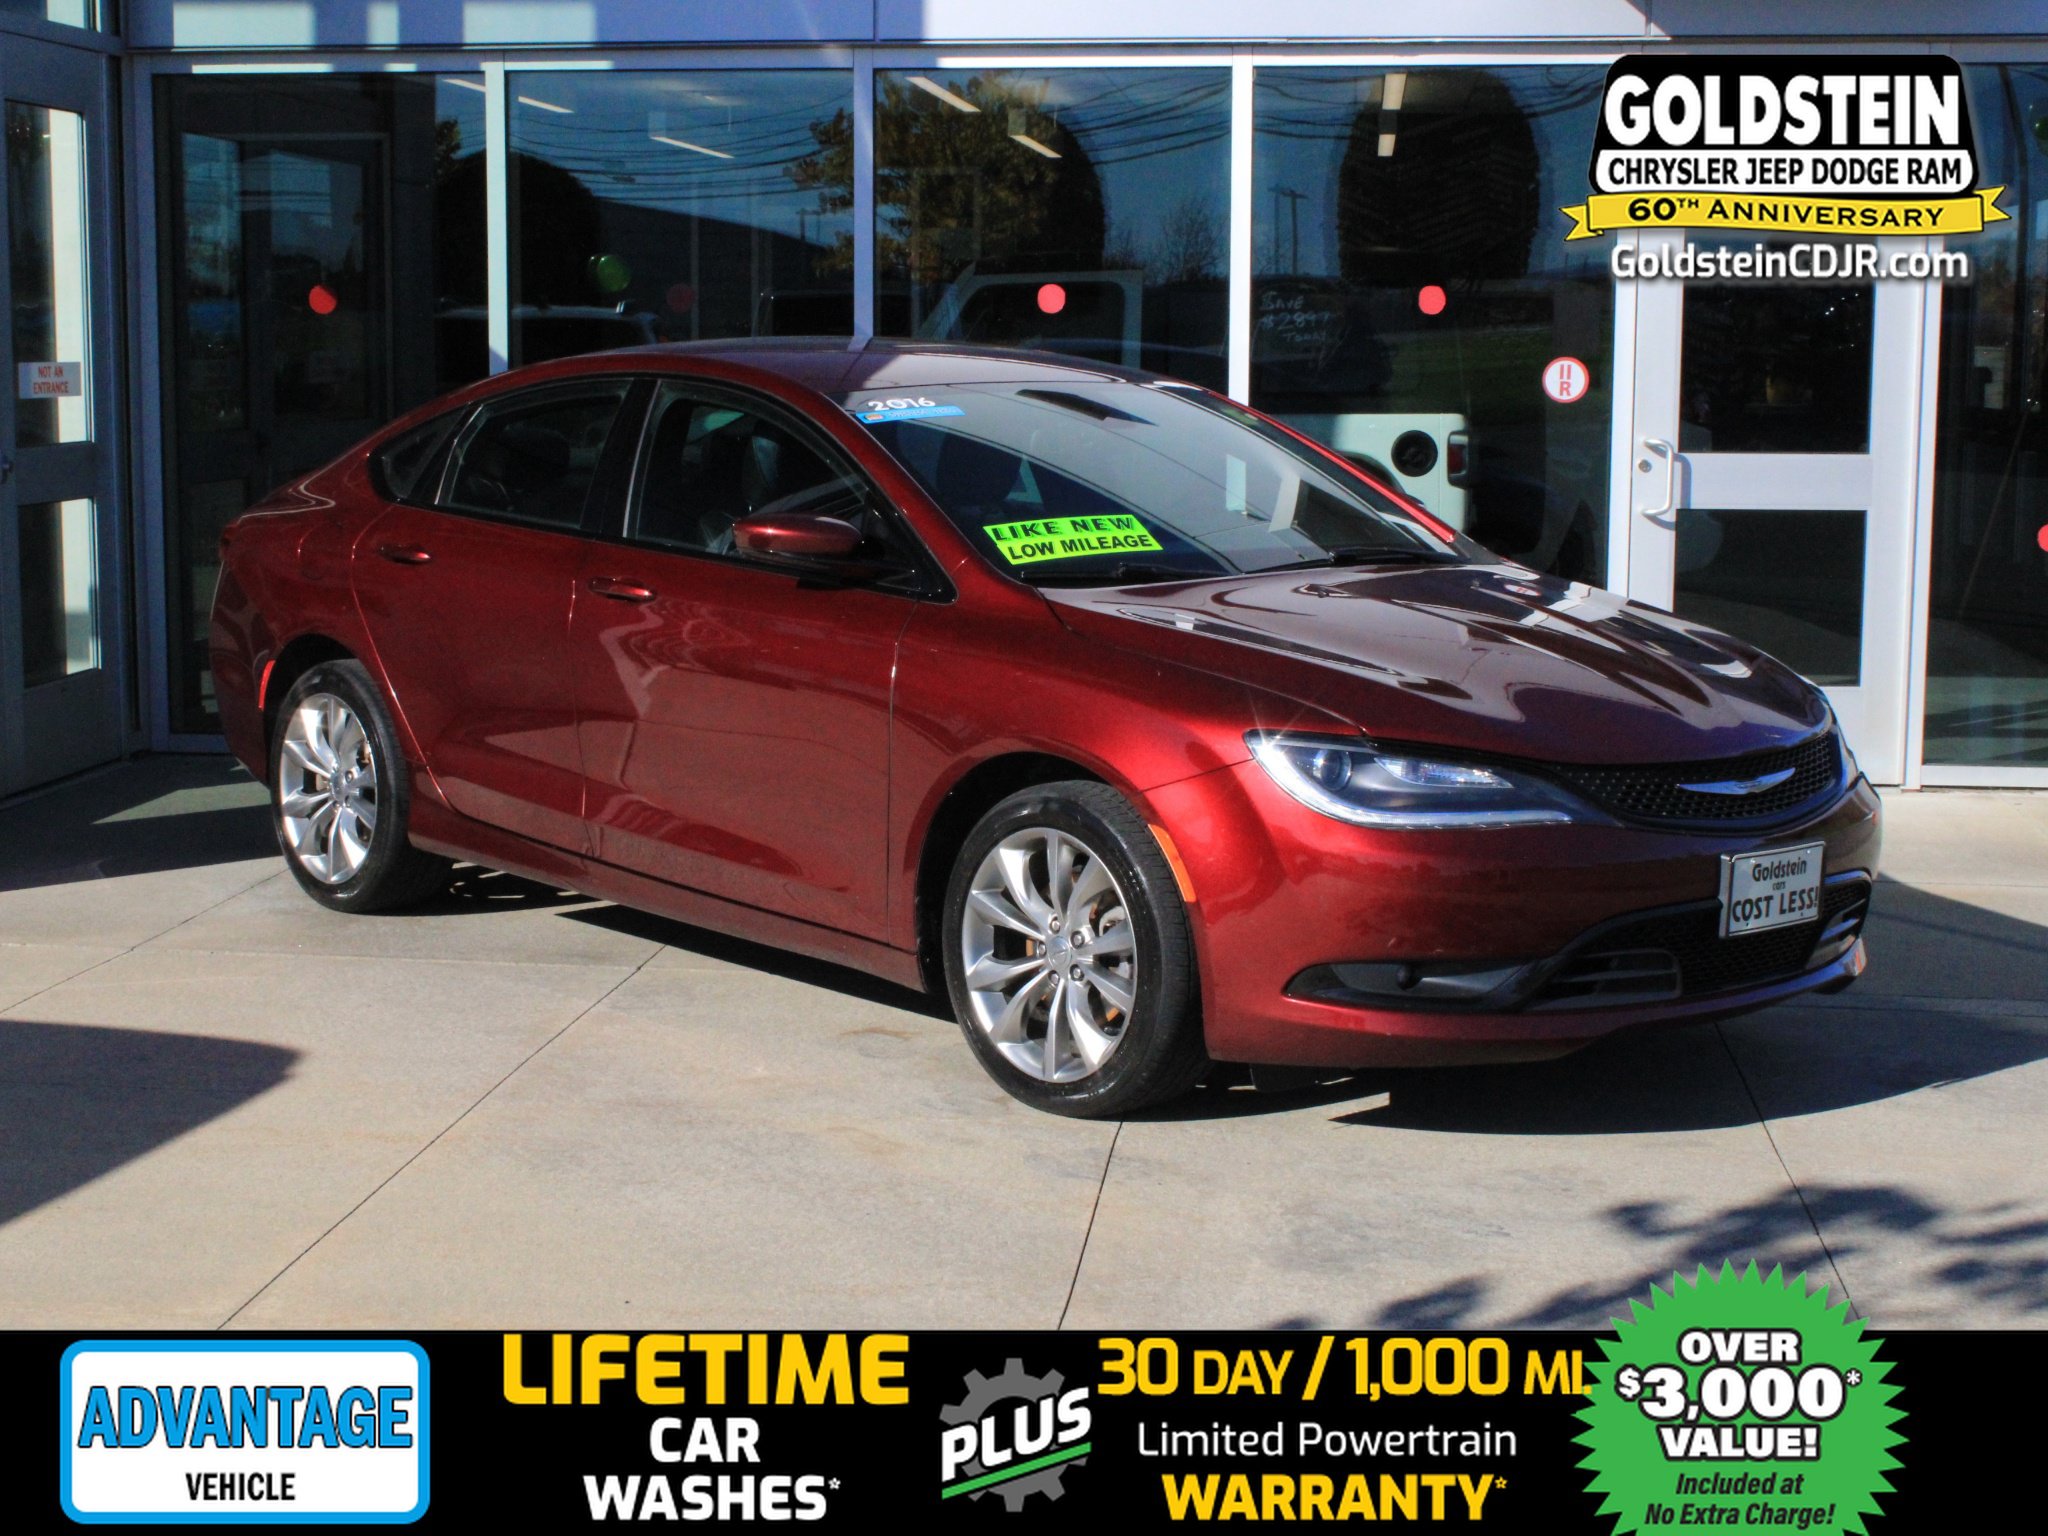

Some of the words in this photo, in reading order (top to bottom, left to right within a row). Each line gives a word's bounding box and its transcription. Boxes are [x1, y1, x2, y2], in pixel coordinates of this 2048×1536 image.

[38, 366, 51, 378] NOT
[54, 366, 64, 377] AN
[33, 381, 69, 395] ENTRANCE
[1559, 381, 1572, 397] R
[868, 397, 936, 412] 2016
[991, 521, 1062, 542] LIKE
[1071, 517, 1134, 535] NEW
[1007, 541, 1055, 560] LOW
[1062, 534, 1153, 554] MILEAGE
[1752, 857, 1808, 882] Goldstein
[1732, 895, 1774, 923] COST
[1778, 886, 1820, 915] LESS!
